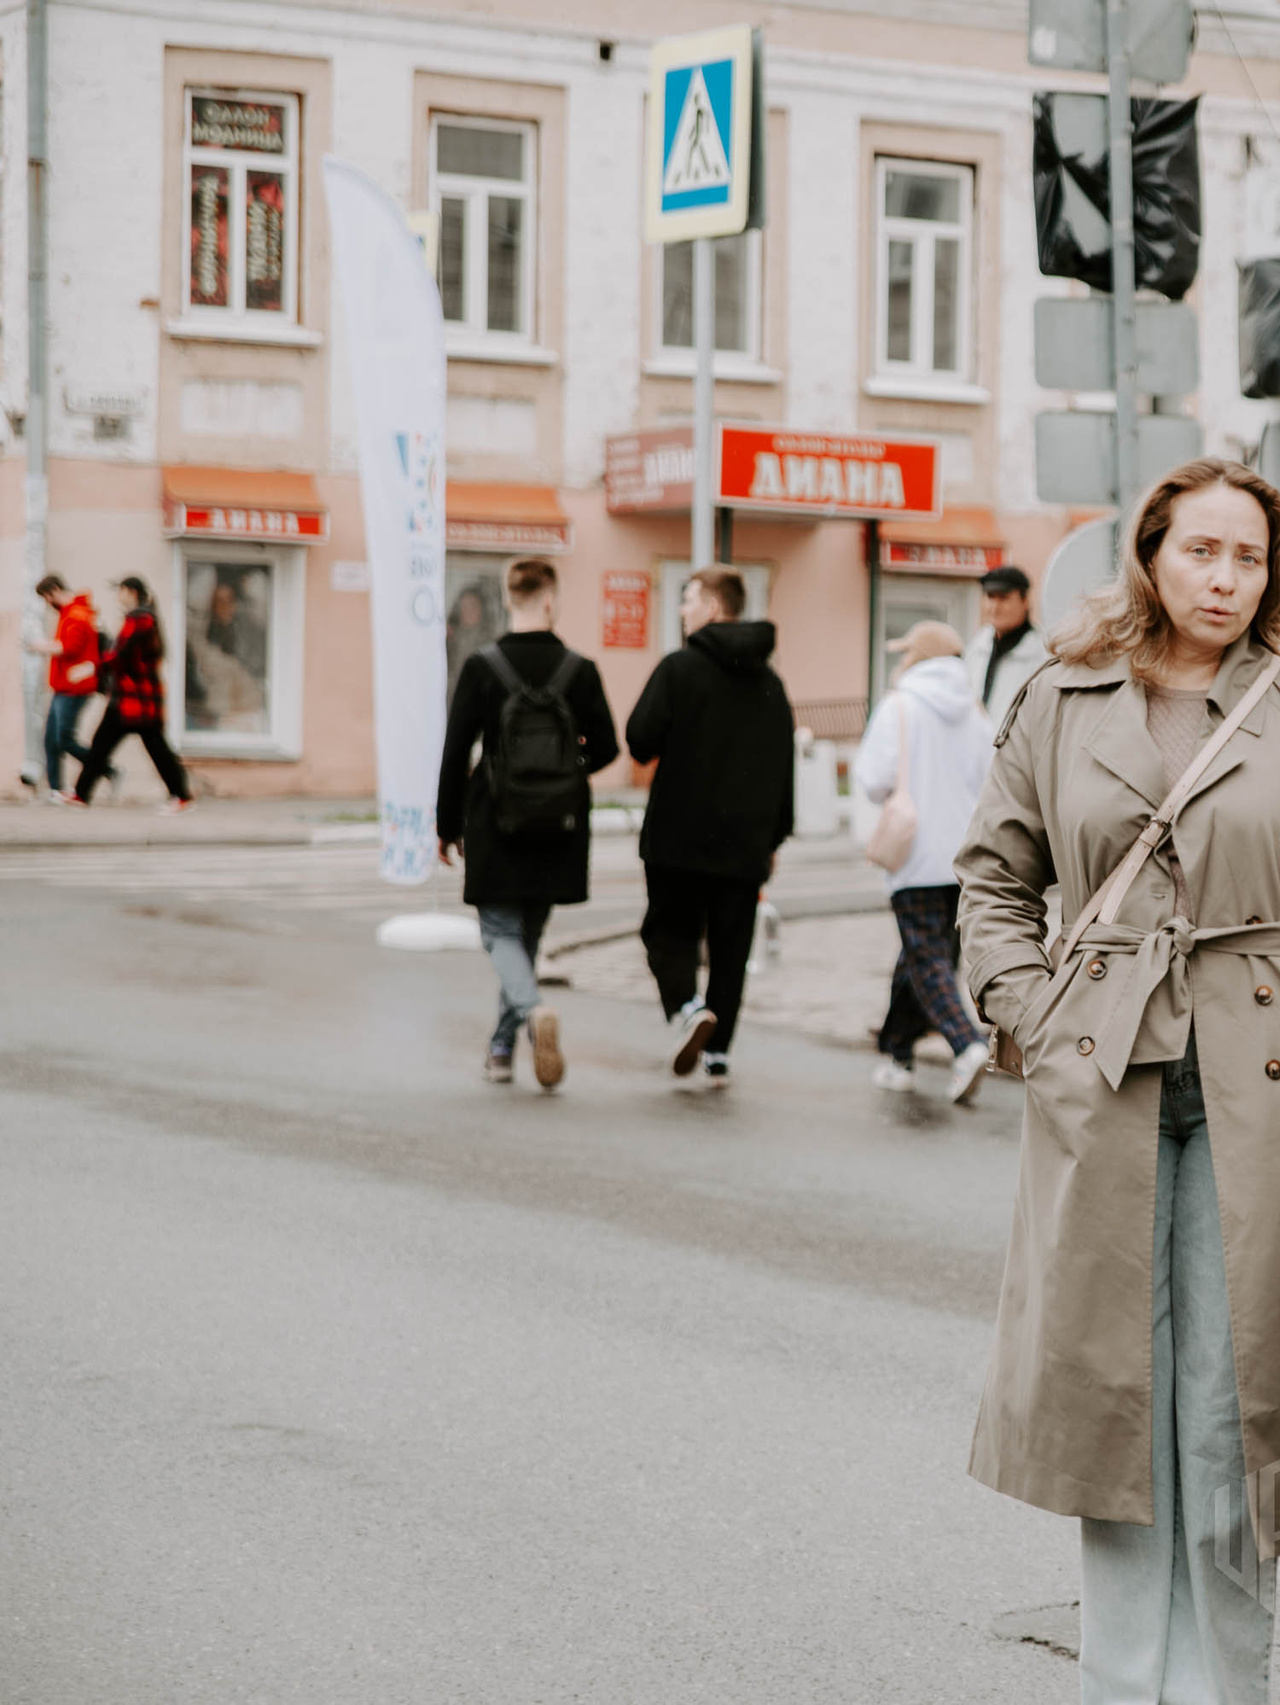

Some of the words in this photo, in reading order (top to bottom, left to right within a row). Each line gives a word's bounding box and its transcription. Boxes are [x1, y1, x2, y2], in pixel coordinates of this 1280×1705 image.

[203, 101, 269, 127] САЛОН
[750, 450, 906, 508] ДИАНА
[212, 508, 300, 534] ДИАНА
